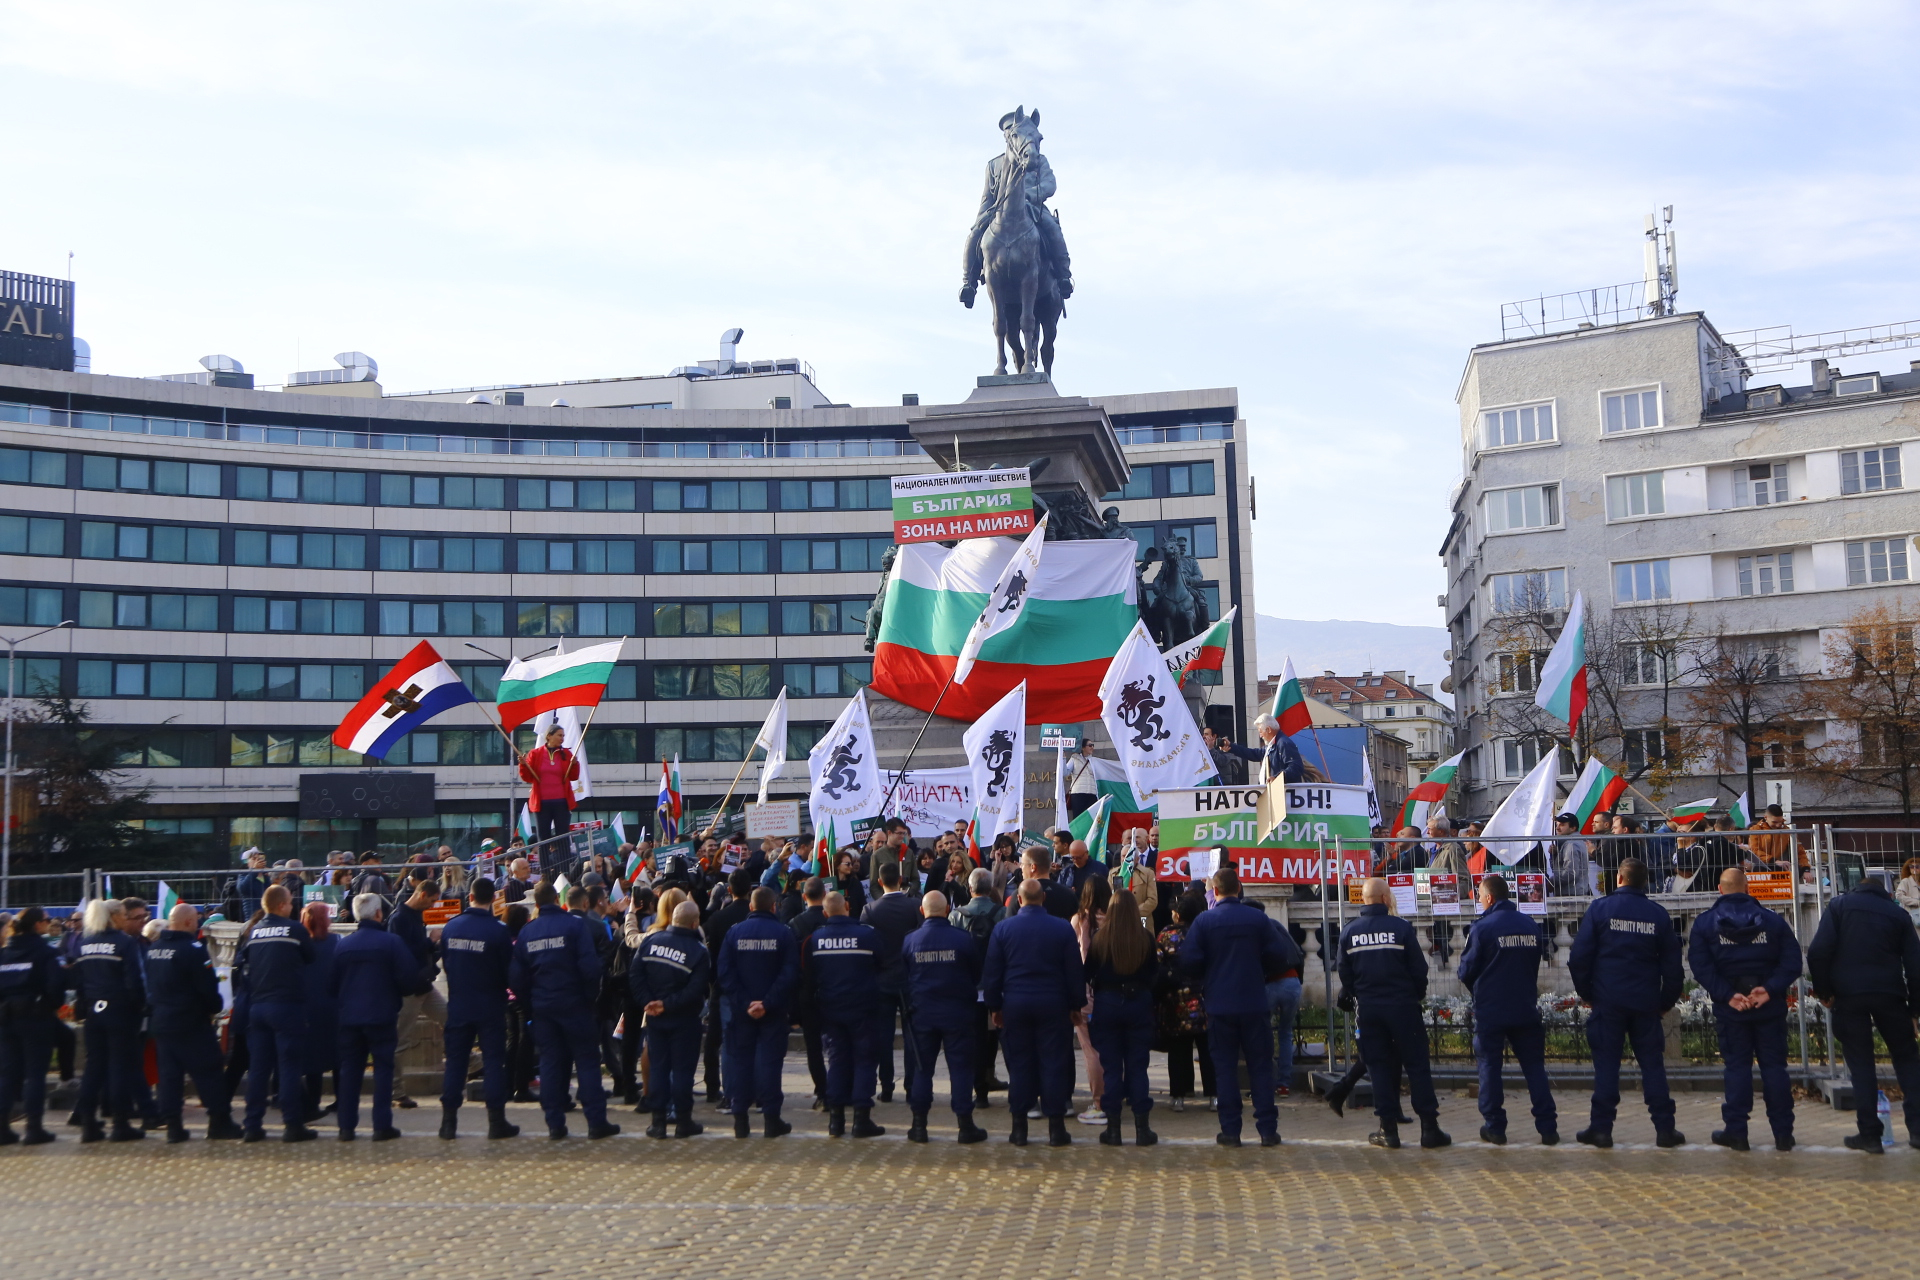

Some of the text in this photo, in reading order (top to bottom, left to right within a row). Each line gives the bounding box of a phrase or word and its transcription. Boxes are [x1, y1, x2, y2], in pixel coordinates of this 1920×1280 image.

[0, 302, 53, 338] AL
[894, 477, 949, 491] НАЦИОНАЛЕН
[950, 475, 983, 486] МИТИНГ
[989, 473, 1027, 483] ШЕСТВИЕ
[912, 493, 1012, 514] БЪЛГАРИЯ
[901, 515, 1028, 538] ЗОНА НА МИРА!
[888, 770, 914, 784] НЕ
[1195, 789, 1332, 811] НАТО ЪН!
[1239, 857, 1275, 878] НА
[252, 926, 291, 939] POLICE
[1609, 918, 1656, 935] SECURITY POLICE
[818, 937, 858, 949] POLICE
[1351, 932, 1396, 946] POLICE
[148, 949, 176, 959] POLICE
[650, 944, 687, 964] POLICE
[914, 950, 956, 963] SECURITY POLICE
